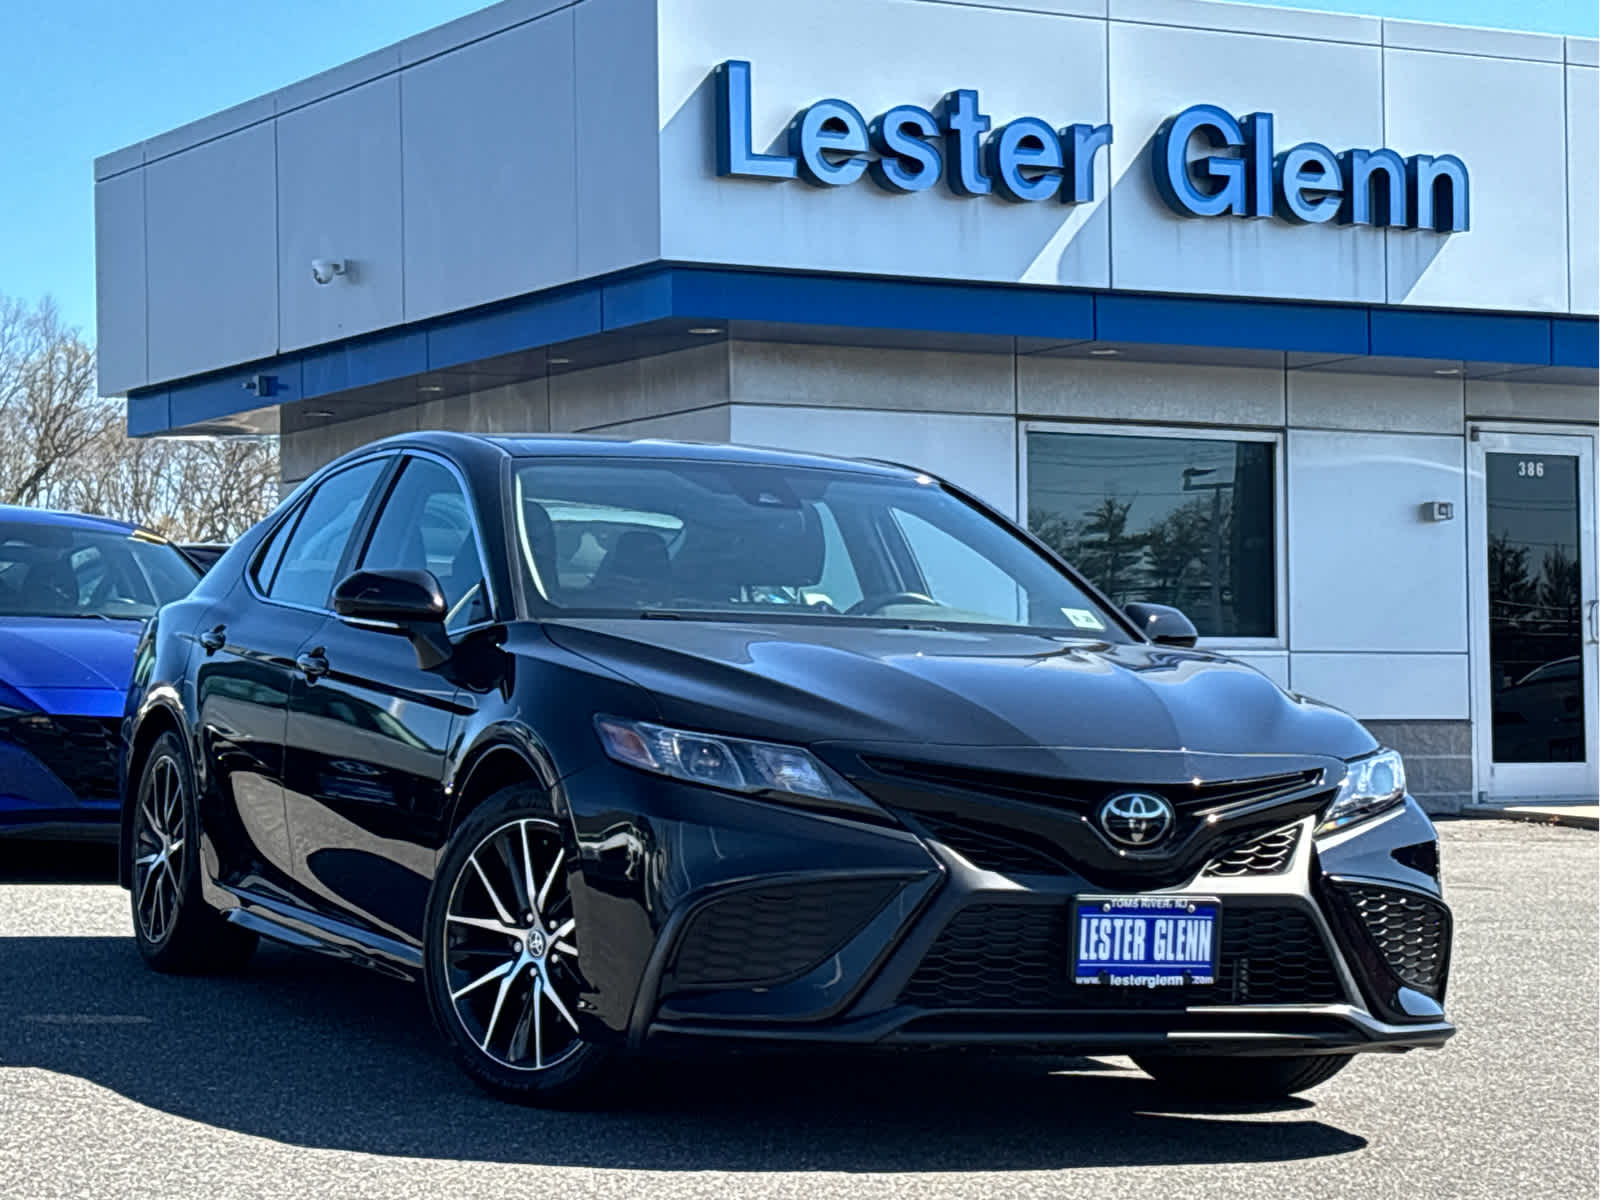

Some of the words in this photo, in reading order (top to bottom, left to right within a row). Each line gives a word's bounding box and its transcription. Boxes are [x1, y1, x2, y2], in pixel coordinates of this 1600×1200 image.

[716, 60, 1113, 203] Lester
[1152, 103, 1470, 233] Glenn
[1518, 461, 1545, 477] 386
[1111, 898, 1139, 908] TOMS
[1174, 899, 1188, 909] NJ
[1079, 918, 1147, 961] LESTER
[1153, 919, 1213, 962] GLENN
[1110, 974, 1184, 989] lesterglenn
